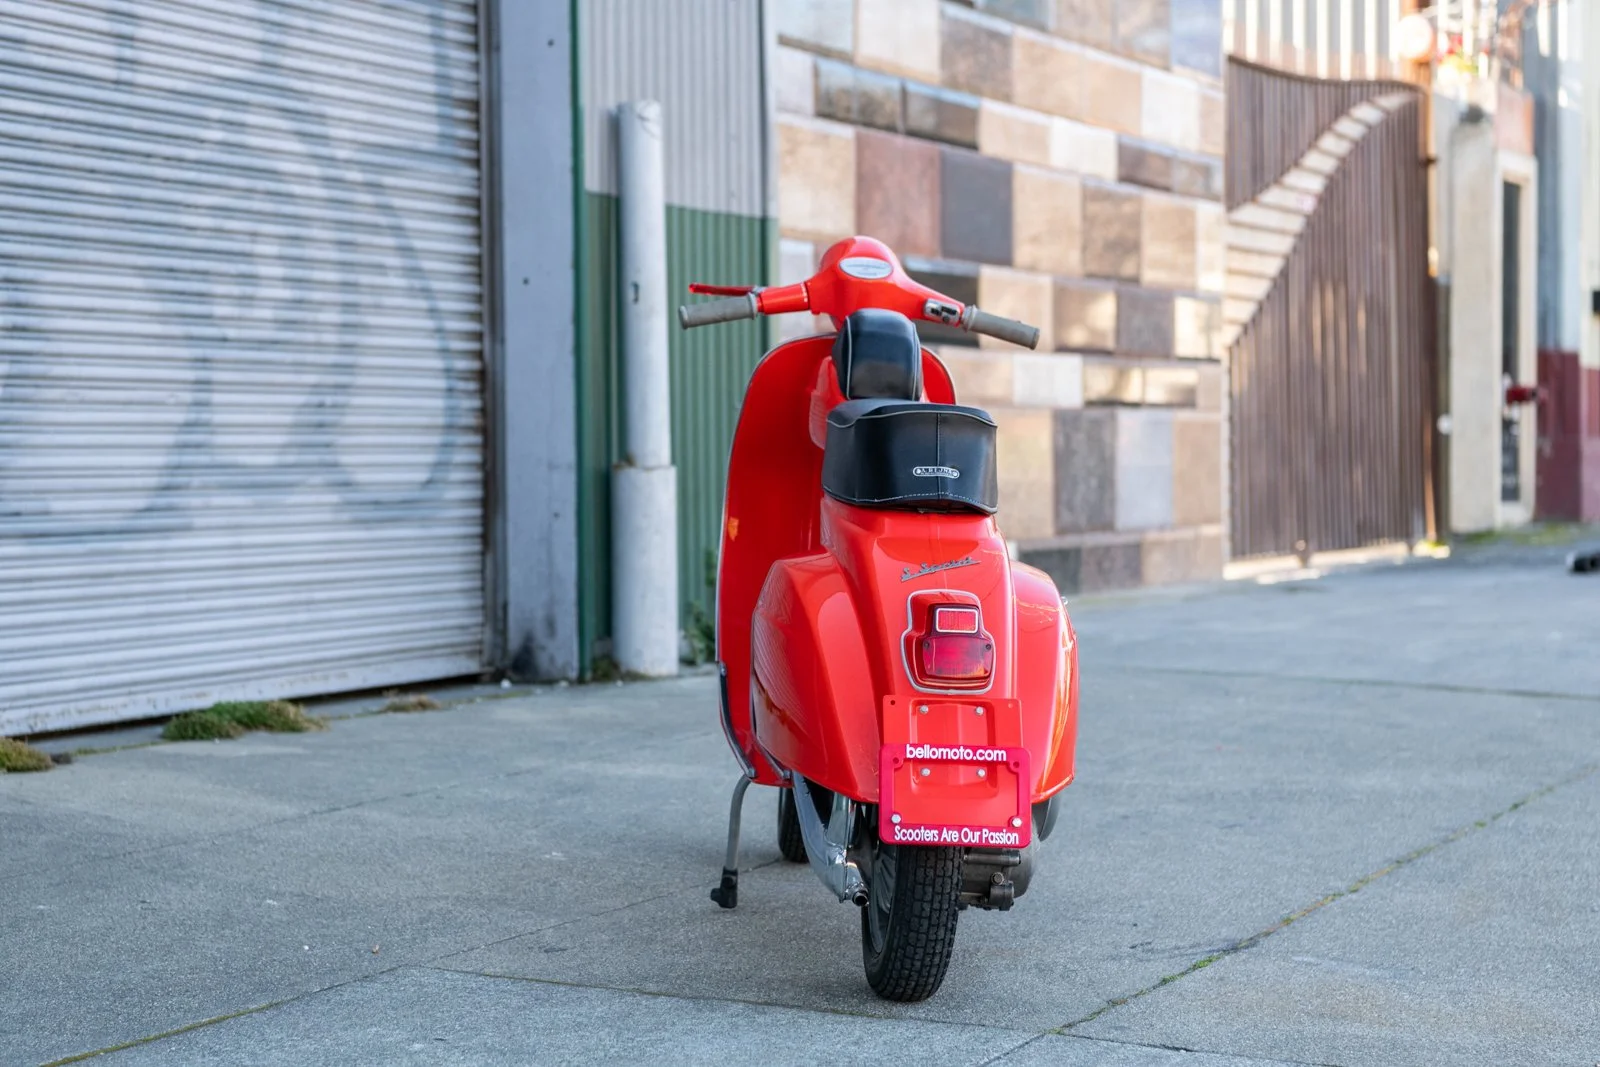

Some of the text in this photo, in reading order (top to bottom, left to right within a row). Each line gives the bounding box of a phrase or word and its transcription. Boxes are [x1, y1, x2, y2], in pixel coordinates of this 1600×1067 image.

[906, 744, 1006, 761] bellomoto.com
[894, 825, 1019, 845] Scooters Are Our Passion
